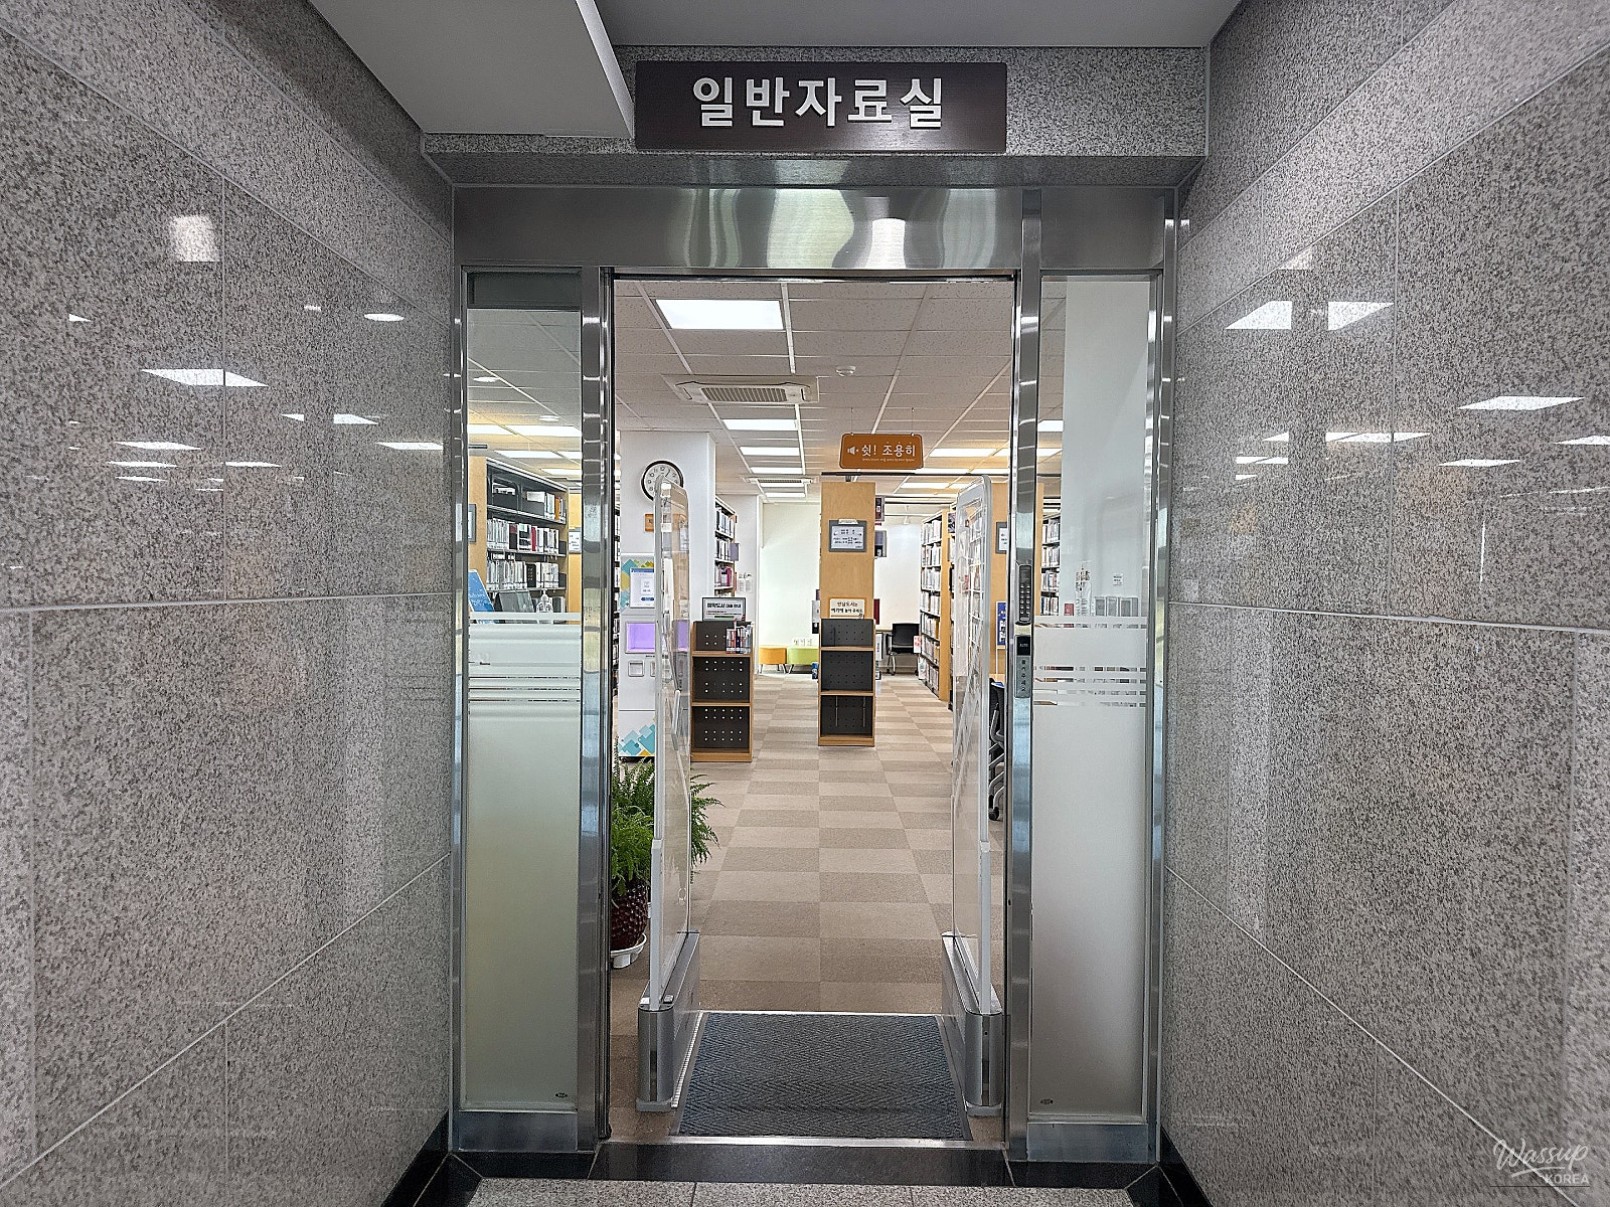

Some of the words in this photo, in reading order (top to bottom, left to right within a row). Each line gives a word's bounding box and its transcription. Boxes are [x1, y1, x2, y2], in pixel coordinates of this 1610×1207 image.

[692, 76, 943, 129] 일반자료실
[861, 444, 877, 457] 쉿!
[882, 443, 916, 458] 조용히
